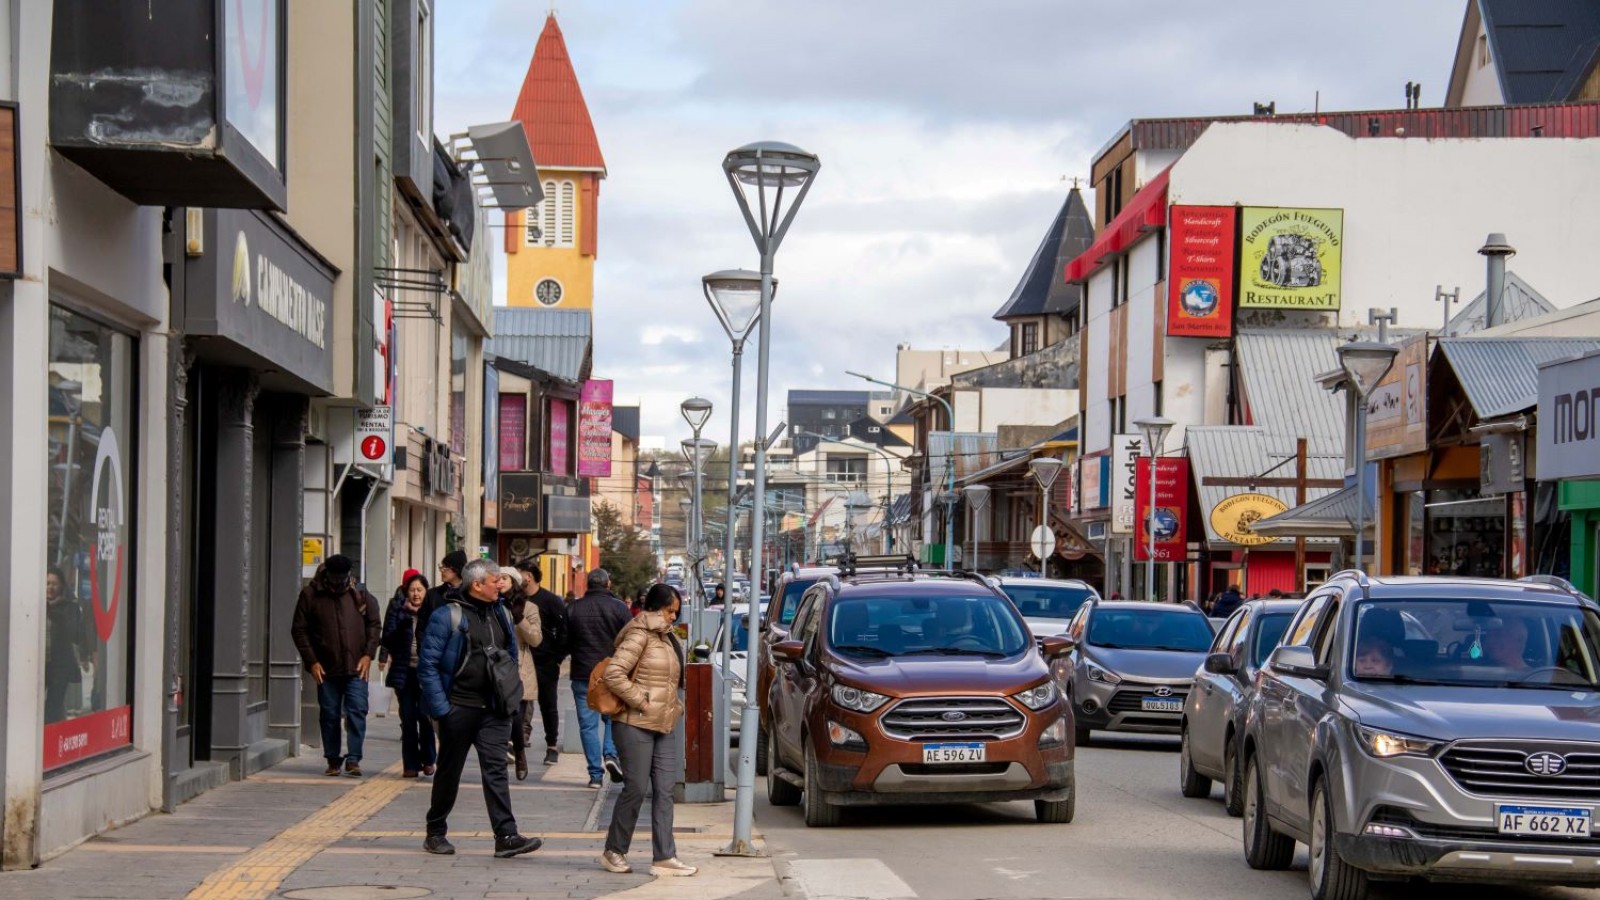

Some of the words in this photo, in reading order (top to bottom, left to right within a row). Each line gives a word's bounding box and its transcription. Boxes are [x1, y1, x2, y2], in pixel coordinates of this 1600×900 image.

[1183, 217, 1222, 227] Handicraft
[1246, 211, 1290, 244] BODEGÓN
[1294, 211, 1339, 247] FUEGUINO
[1184, 236, 1219, 246] Silvercraft
[1245, 291, 1336, 306] RESTAURANT
[1124, 439, 1141, 500] Kodak
[1224, 532, 1275, 545] RESTAURAN
[926, 750, 941, 762] AE
[943, 749, 965, 761] 596
[968, 749, 983, 761] ZV
[1503, 815, 1524, 830] AF
[1529, 816, 1560, 832] 662
[1566, 817, 1586, 834] XZ
